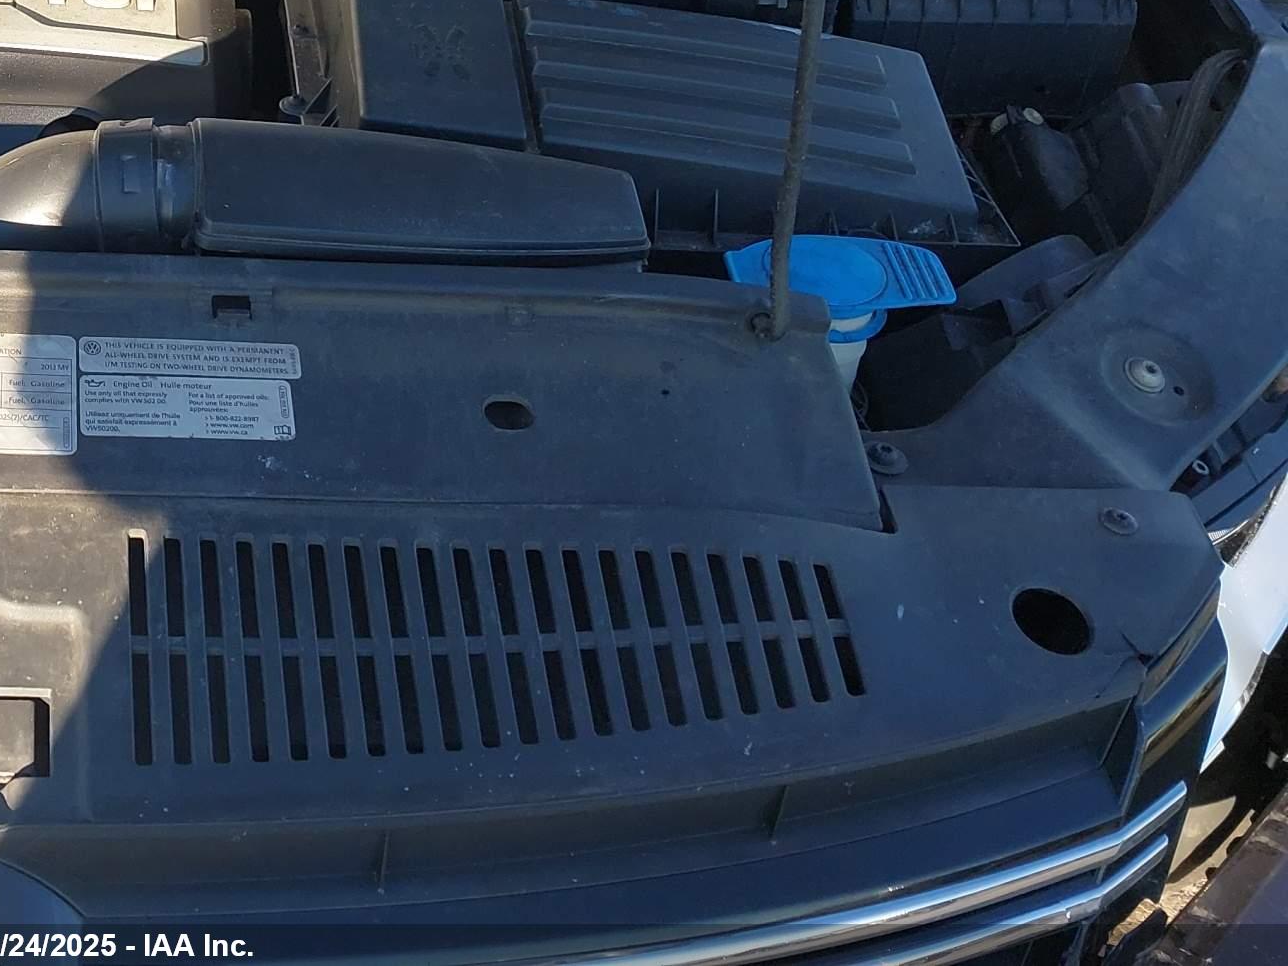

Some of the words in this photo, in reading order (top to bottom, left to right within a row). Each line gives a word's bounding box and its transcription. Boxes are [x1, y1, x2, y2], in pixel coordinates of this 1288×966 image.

[167, 344, 204, 352] EQUIPPED
[238, 347, 284, 355] PERMANENT
[114, 381, 140, 389] Engine
